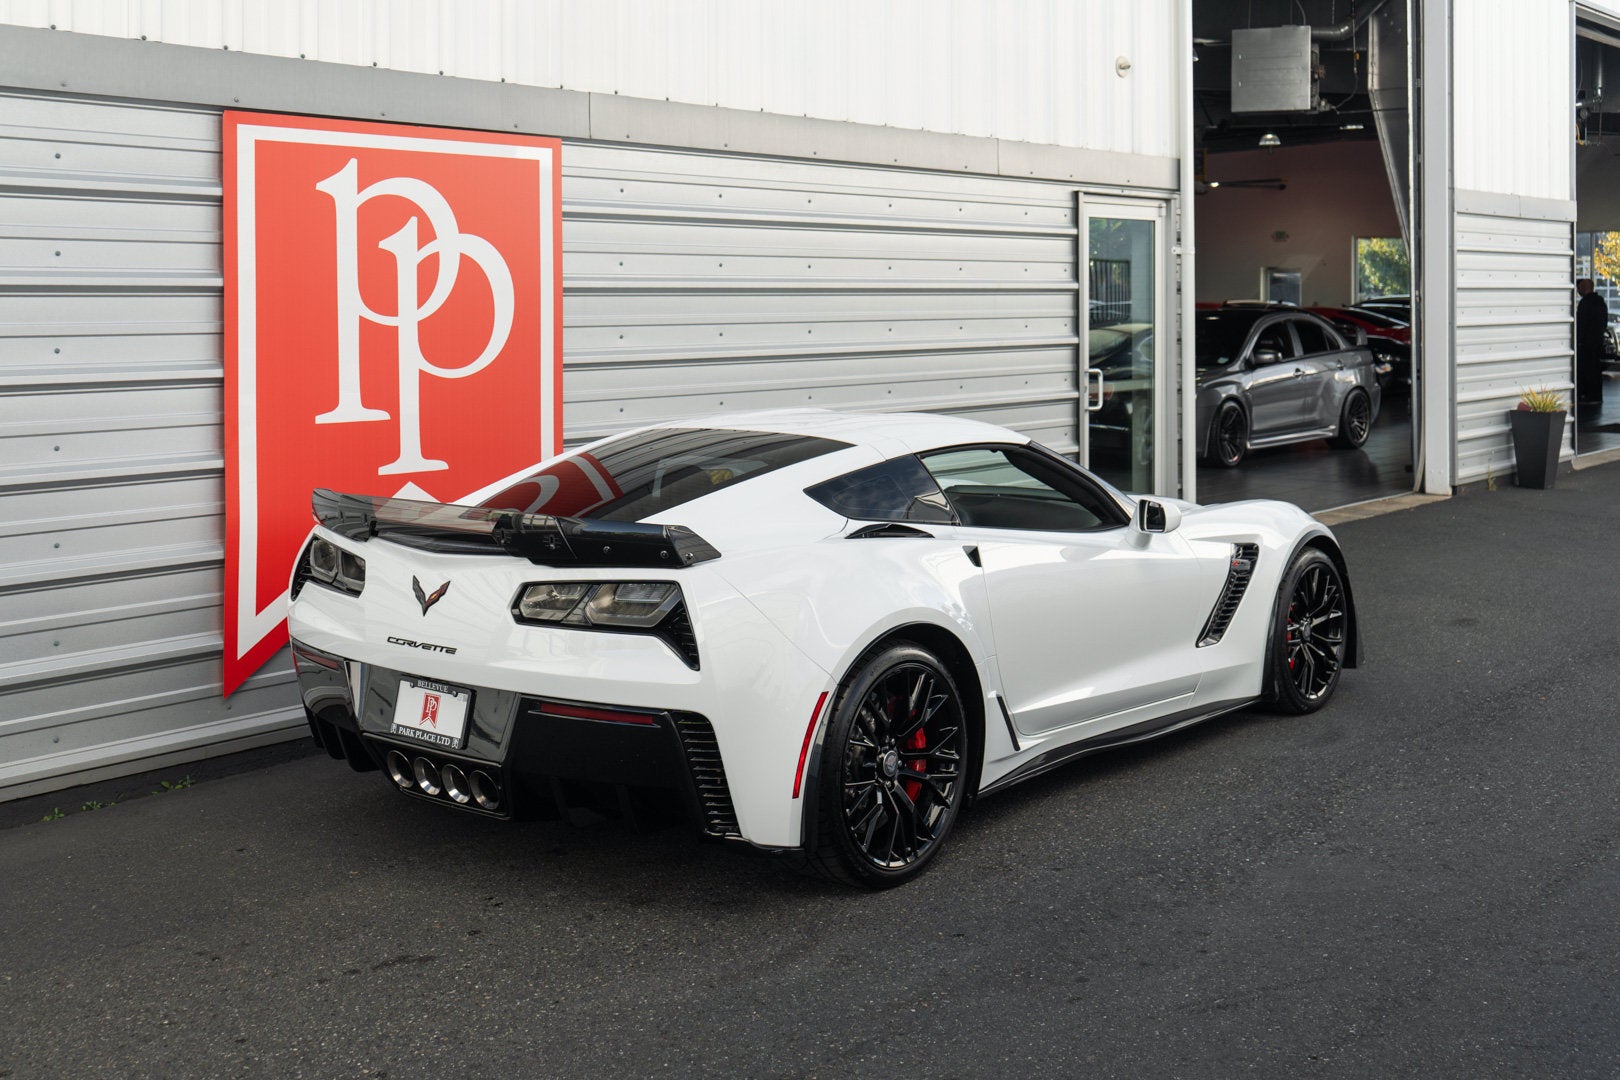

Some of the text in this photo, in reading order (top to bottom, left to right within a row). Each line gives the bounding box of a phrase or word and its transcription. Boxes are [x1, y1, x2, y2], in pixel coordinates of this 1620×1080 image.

[387, 636, 457, 655] CORVETTE
[417, 680, 449, 693] BELLEVUE
[398, 726, 415, 737] PARK
[415, 730, 437, 743] PLACE
[436, 736, 451, 746] LTD
